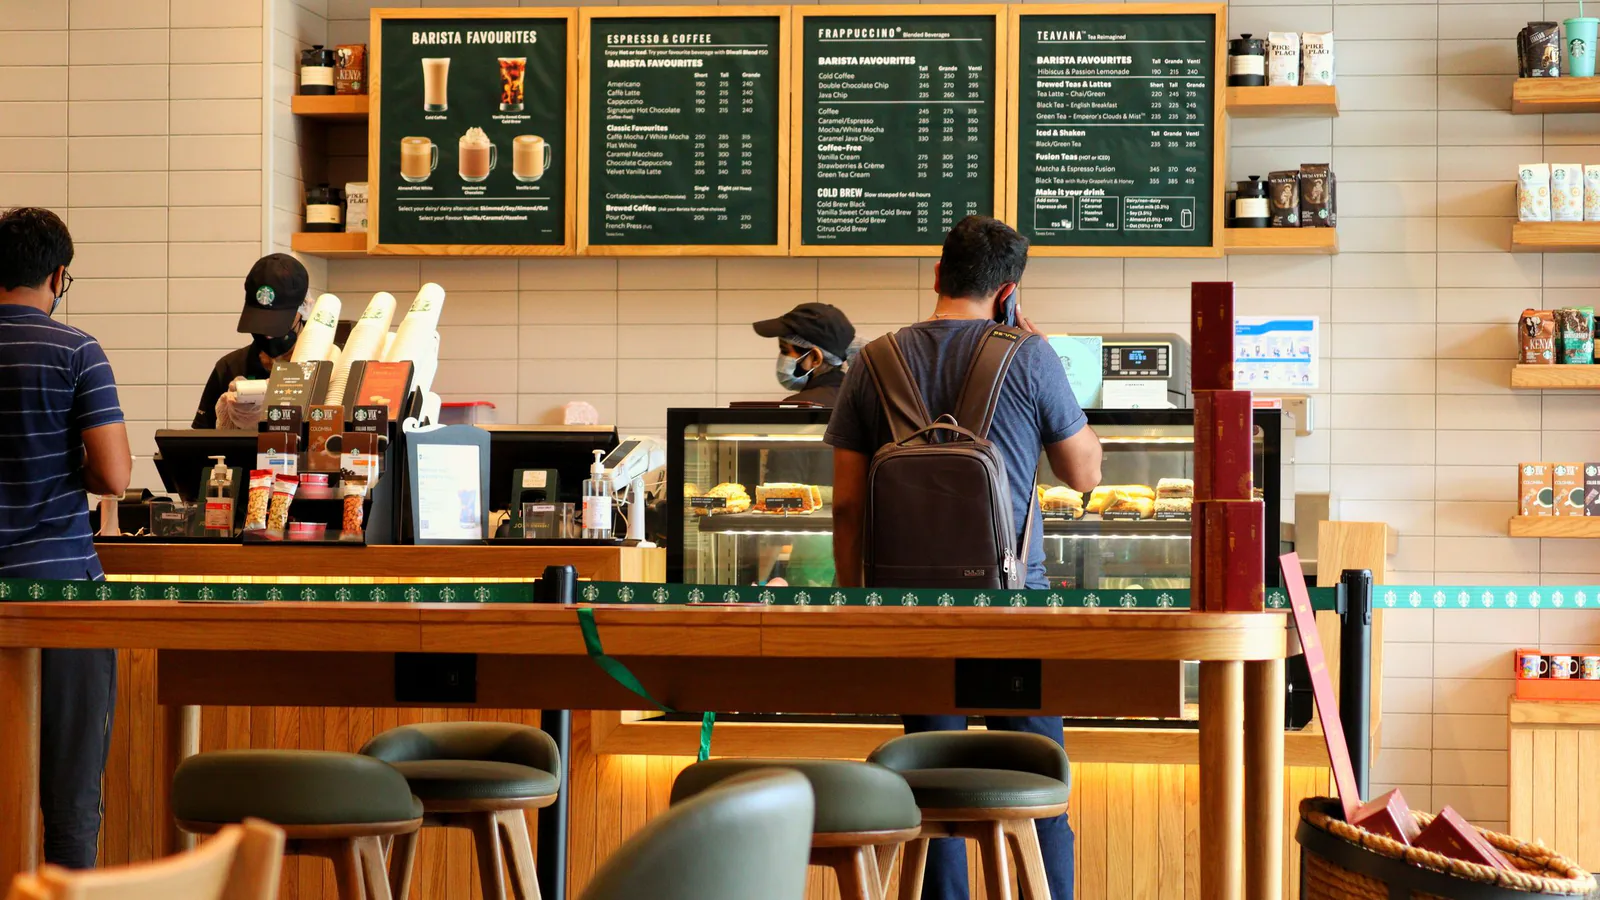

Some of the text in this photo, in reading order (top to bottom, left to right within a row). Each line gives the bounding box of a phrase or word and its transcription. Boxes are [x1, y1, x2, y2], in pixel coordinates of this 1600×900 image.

[412, 31, 536, 44] BARISTA FAVOURITES
[607, 34, 711, 44] ESPRESSO & COFFEE
[648, 59, 703, 67] FAVOURITES
[860, 56, 915, 64] FAVOURITES
[818, 188, 838, 197] COLD
[840, 188, 862, 197] BREW
[1058, 188, 1064, 196] it
[1084, 188, 1104, 196] drink
[1530, 338, 1553, 350] KENYA
